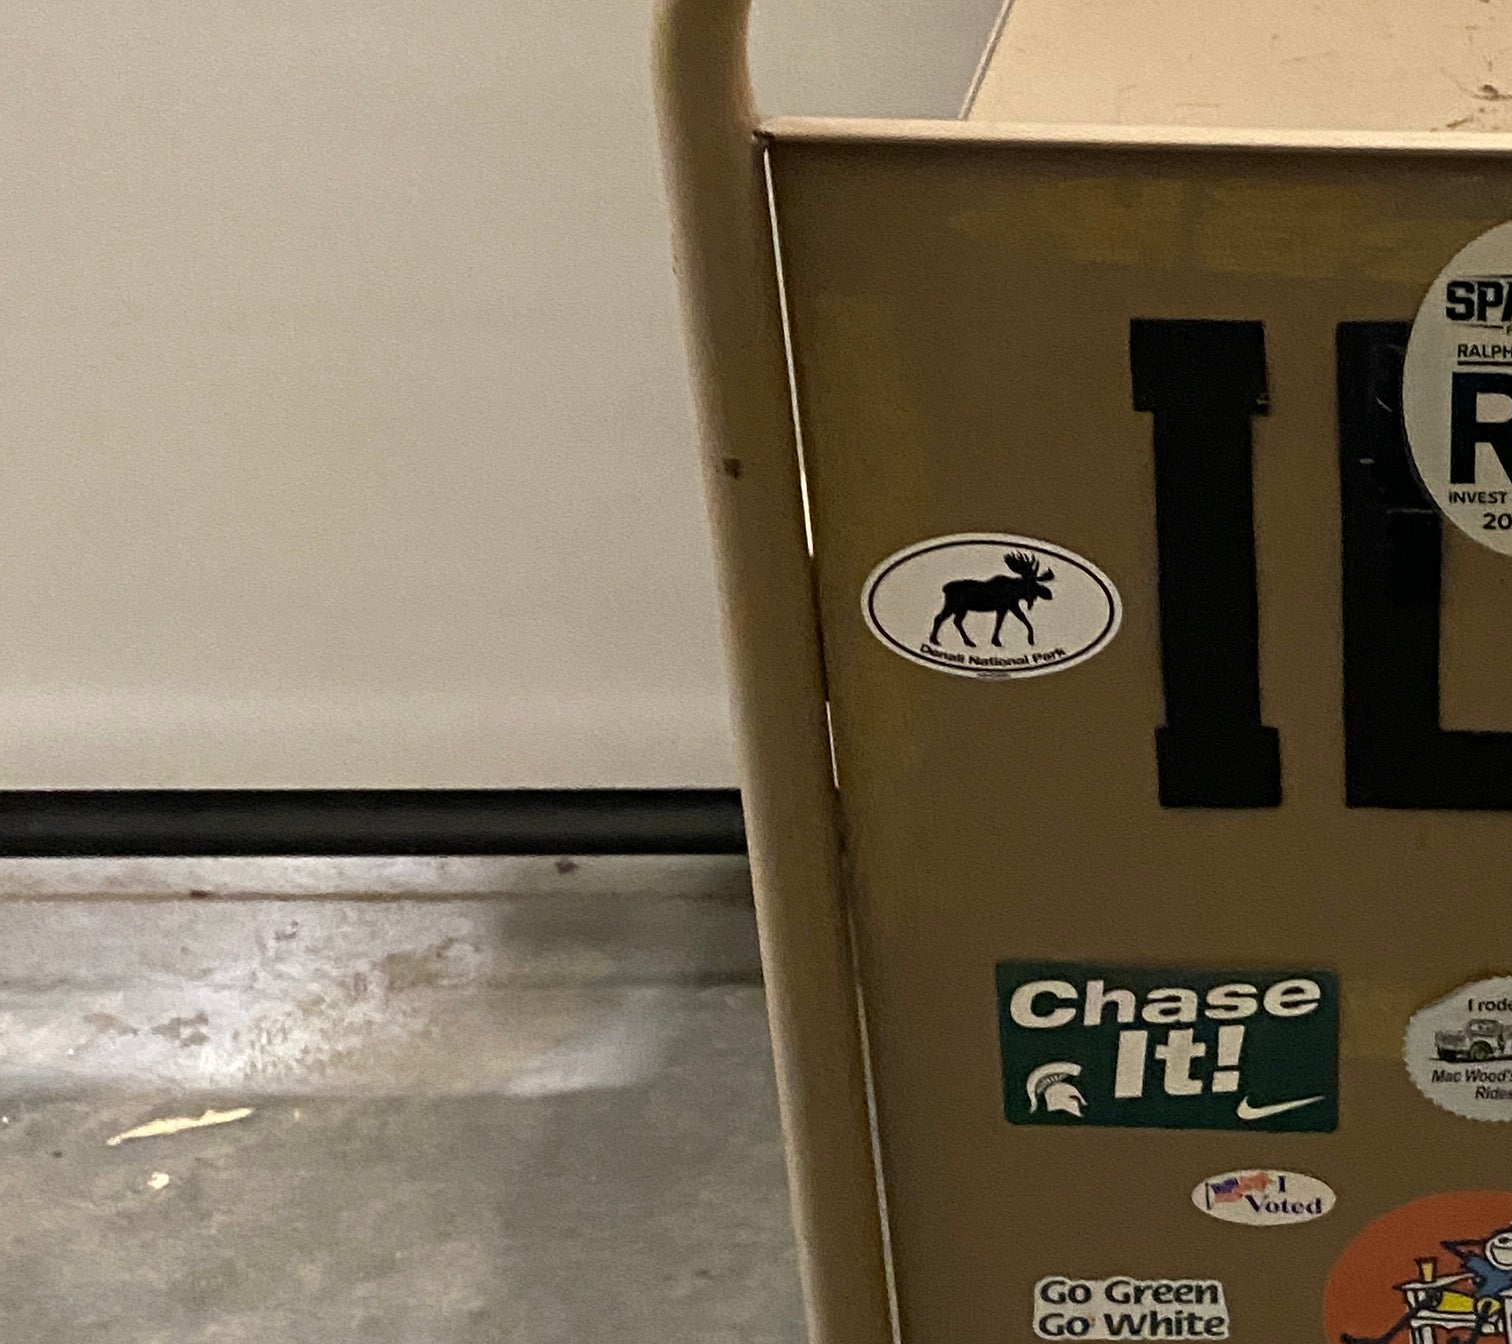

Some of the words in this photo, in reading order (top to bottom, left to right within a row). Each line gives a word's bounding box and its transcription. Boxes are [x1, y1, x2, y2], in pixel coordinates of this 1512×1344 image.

[1448, 491, 1507, 504] INVEST
[919, 643, 965, 664] Denali
[968, 655, 1030, 666] National
[1032, 647, 1066, 663] Park
[1009, 978, 1321, 1029] Chase
[1114, 1025, 1246, 1099] It!
[1431, 1069, 1461, 1083] Mac
[1277, 1174, 1287, 1193] I
[1245, 1194, 1323, 1215] Voted
[1039, 1280, 1092, 1305] Go
[1104, 1280, 1219, 1305] Green
[1038, 1313, 1090, 1336] Go
[1103, 1310, 1226, 1337] White
